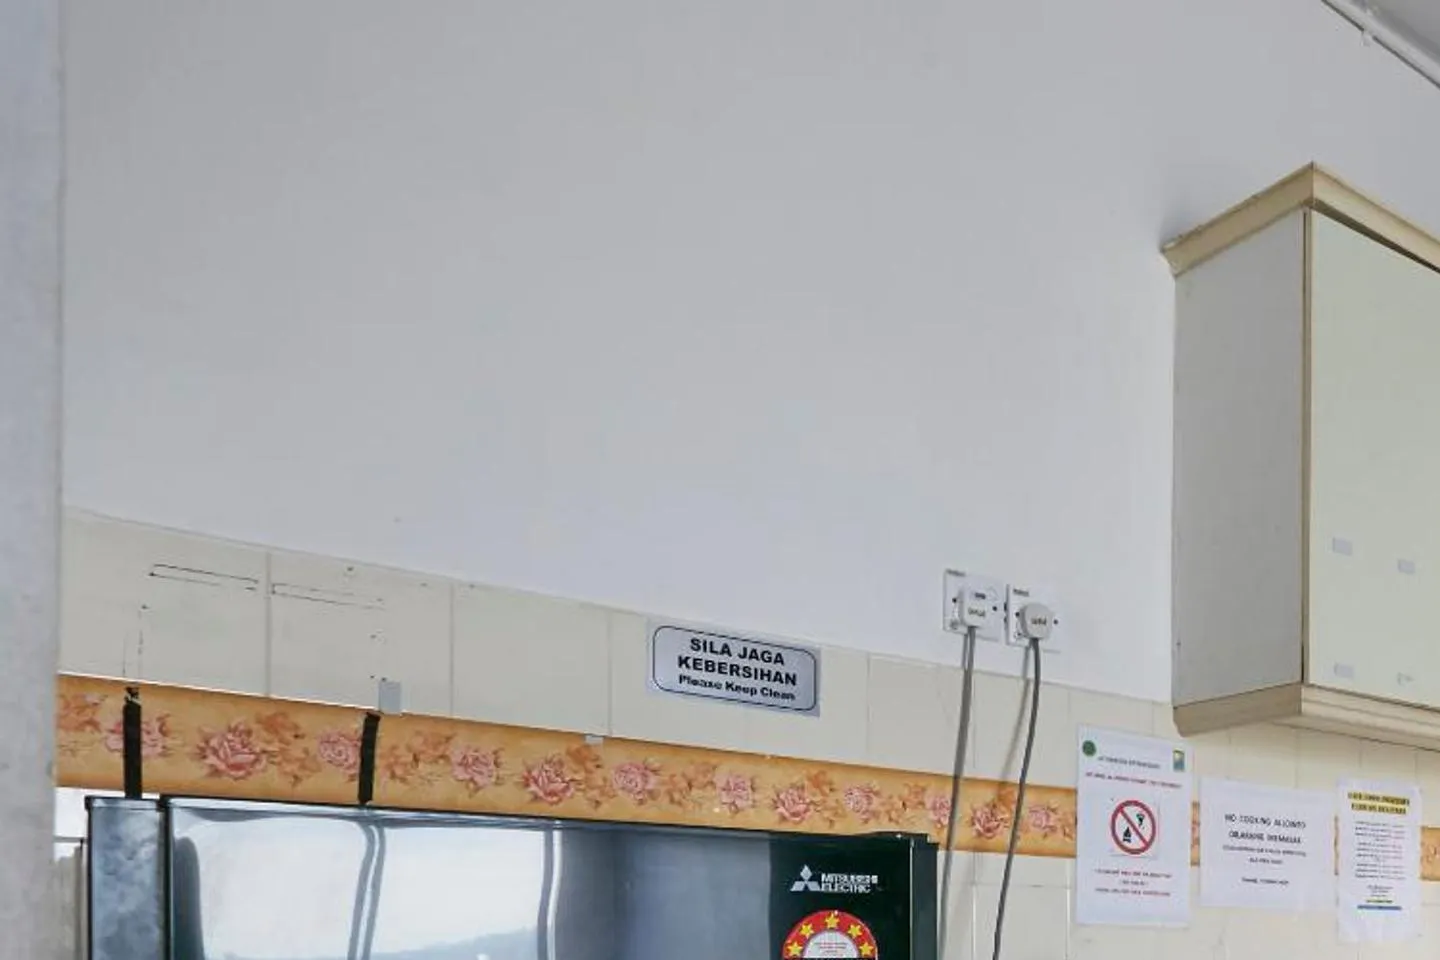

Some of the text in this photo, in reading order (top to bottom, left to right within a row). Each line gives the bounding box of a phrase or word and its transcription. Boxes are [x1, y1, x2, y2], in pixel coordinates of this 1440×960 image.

[690, 638, 785, 666] SILA JAGA
[678, 655, 798, 686] KEBERSIHAN
[679, 674, 796, 701] Please Keep Clean
[821, 883, 872, 893] ELECTRIC
